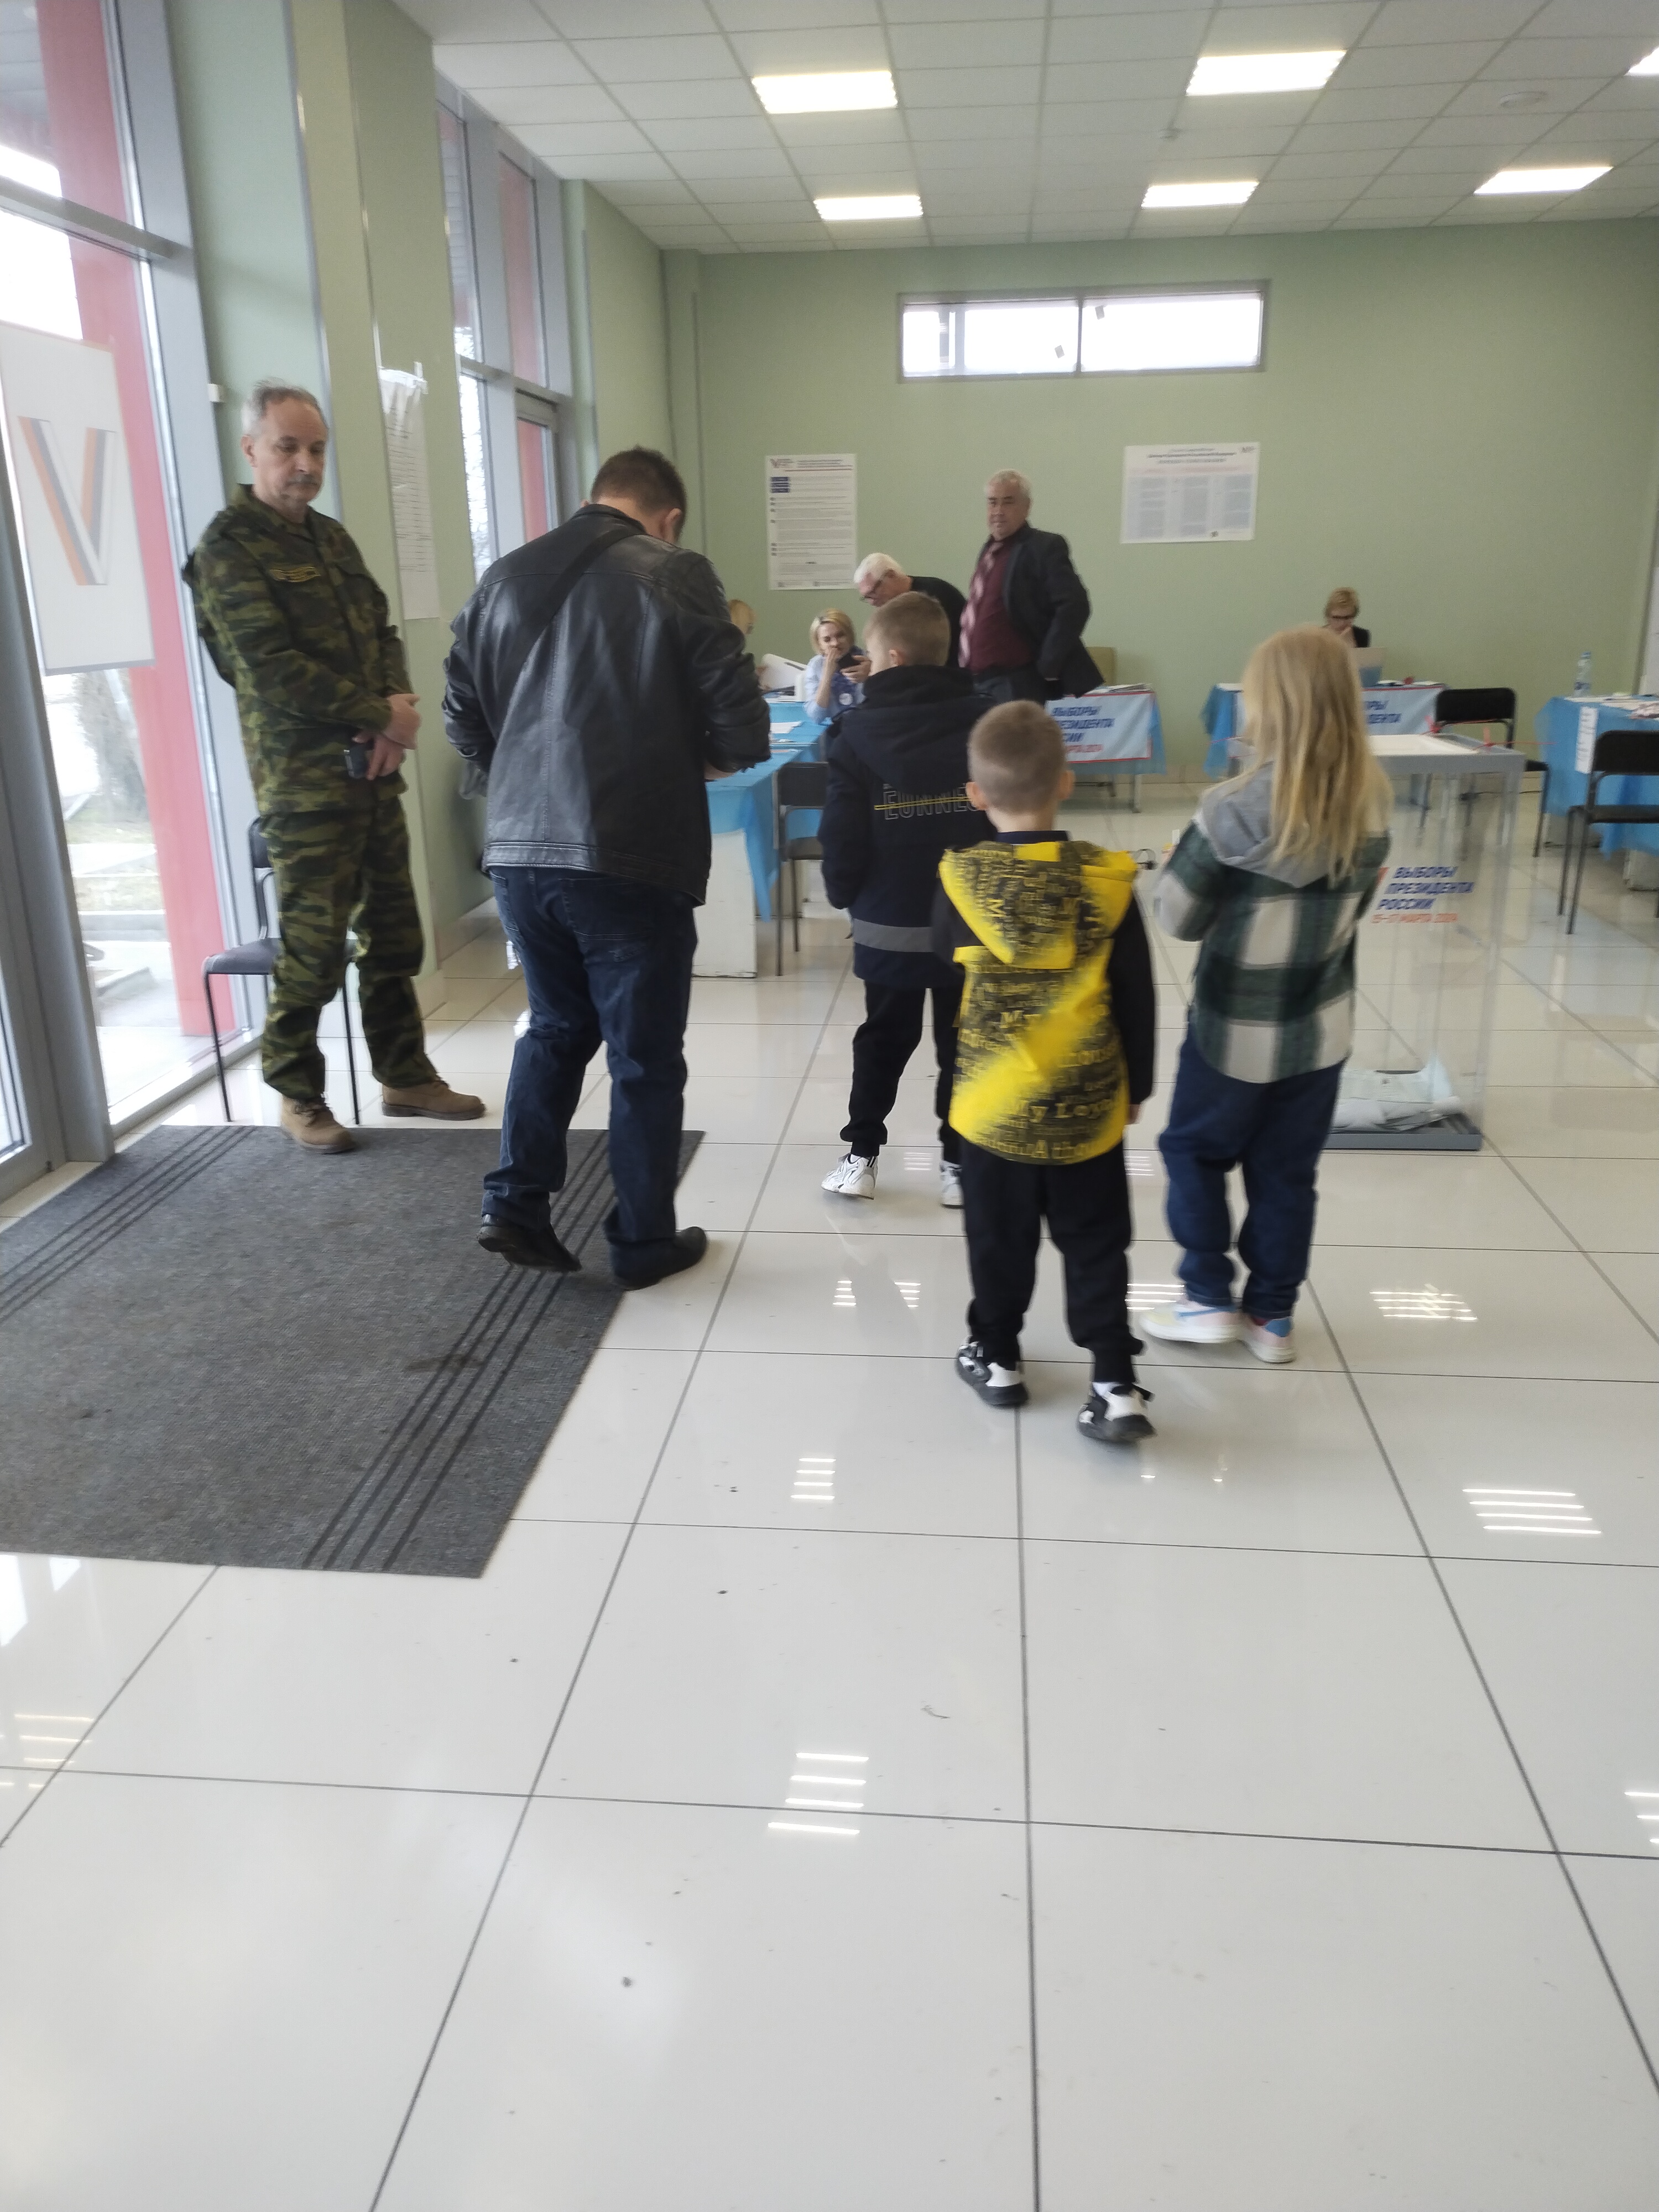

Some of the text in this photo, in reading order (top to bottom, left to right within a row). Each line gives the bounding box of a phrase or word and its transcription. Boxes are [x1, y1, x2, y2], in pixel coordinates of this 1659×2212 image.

[1057, 719, 1115, 729] ЕЗИДЕНТА
[1393, 867, 1458, 878] ВЫБОРЫ
[1384, 882, 1474, 895] ПРЕЗИДЕНТА
[1376, 899, 1436, 910] РОССИИ
